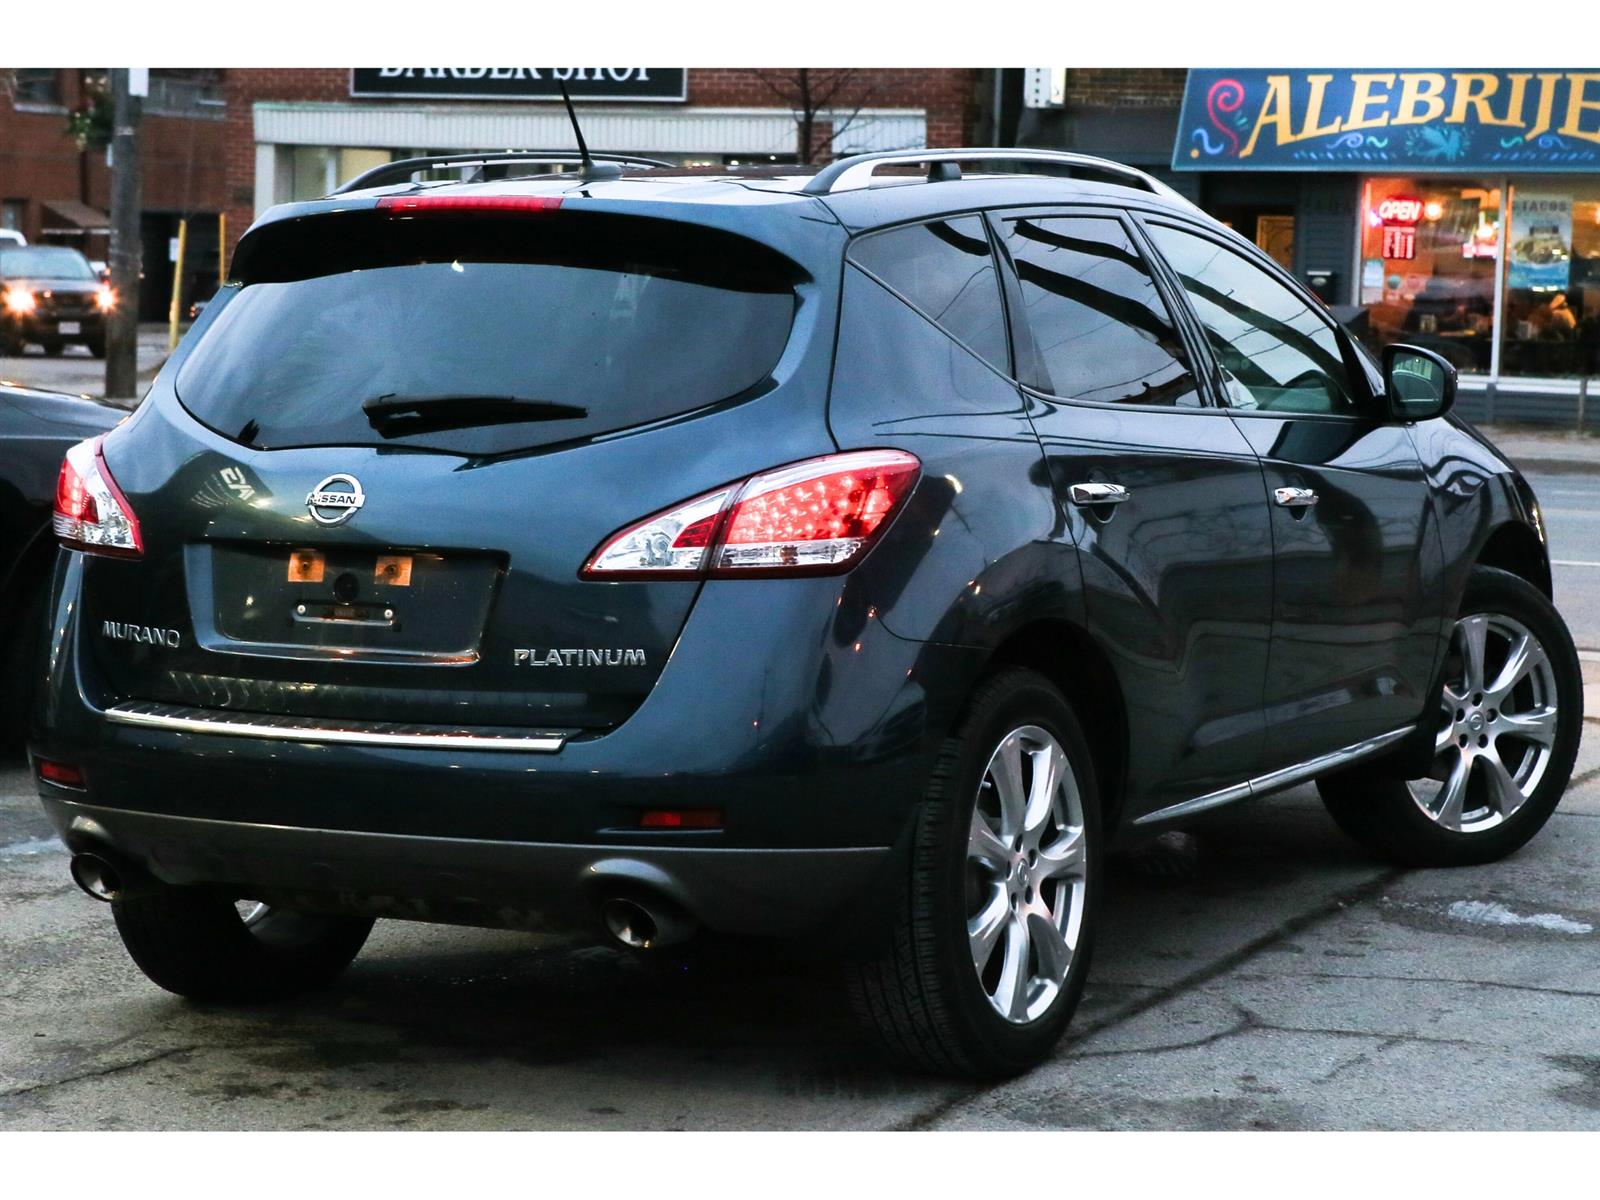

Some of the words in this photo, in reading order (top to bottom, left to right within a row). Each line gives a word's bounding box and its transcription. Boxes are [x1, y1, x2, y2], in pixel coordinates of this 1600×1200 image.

[1239, 73, 1600, 158] ALEBRIJE
[1378, 200, 1421, 221] OPEN
[1521, 200, 1568, 212] TACOS
[102, 620, 181, 648] MURANO
[513, 648, 647, 666] PLATINUM
